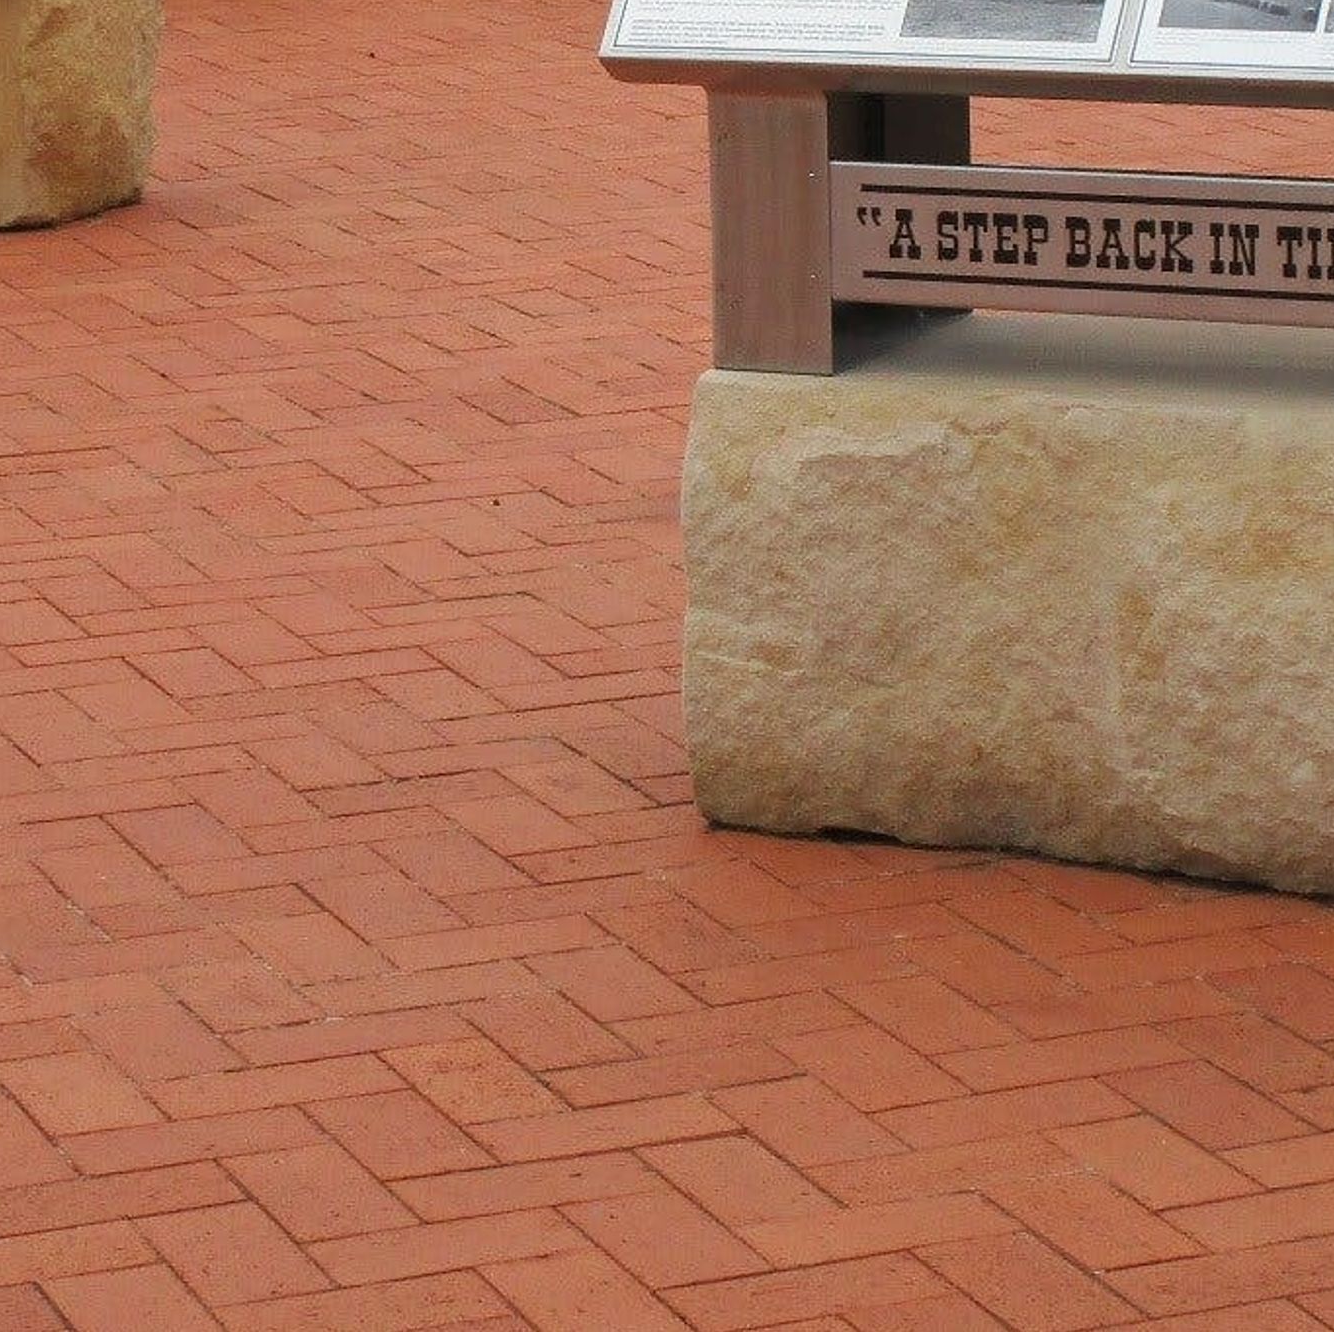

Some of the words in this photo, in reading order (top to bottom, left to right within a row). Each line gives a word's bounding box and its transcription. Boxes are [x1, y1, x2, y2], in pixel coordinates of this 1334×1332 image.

[936, 210, 1049, 266] STEP
[1066, 217, 1194, 274] BACK
[1209, 223, 1260, 276] IN
